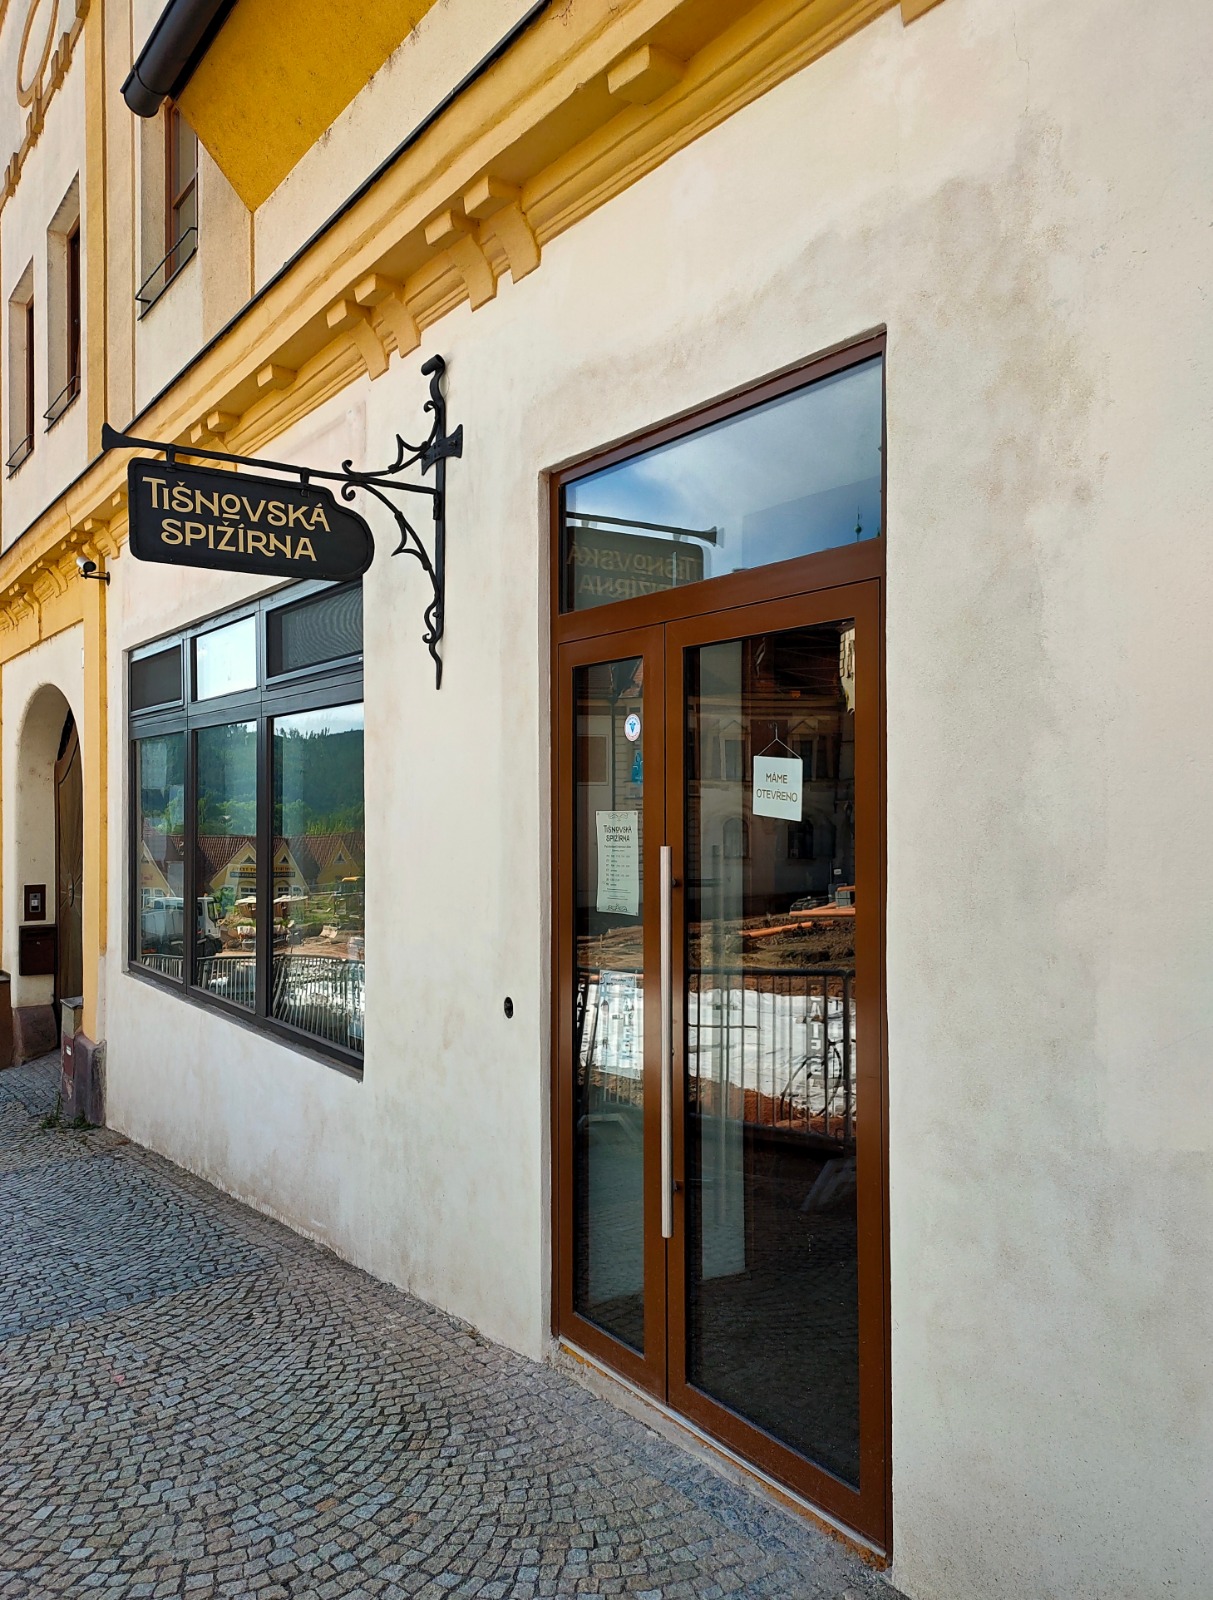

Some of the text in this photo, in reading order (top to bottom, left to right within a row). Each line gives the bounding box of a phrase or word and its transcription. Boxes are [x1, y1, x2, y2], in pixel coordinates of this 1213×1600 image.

[142, 476, 332, 533] TIŠNOVSKÁ
[160, 518, 318, 562] SPIŽÍRNA
[765, 771, 788, 784] MÁME
[756, 788, 798, 803] OTEVŘENO
